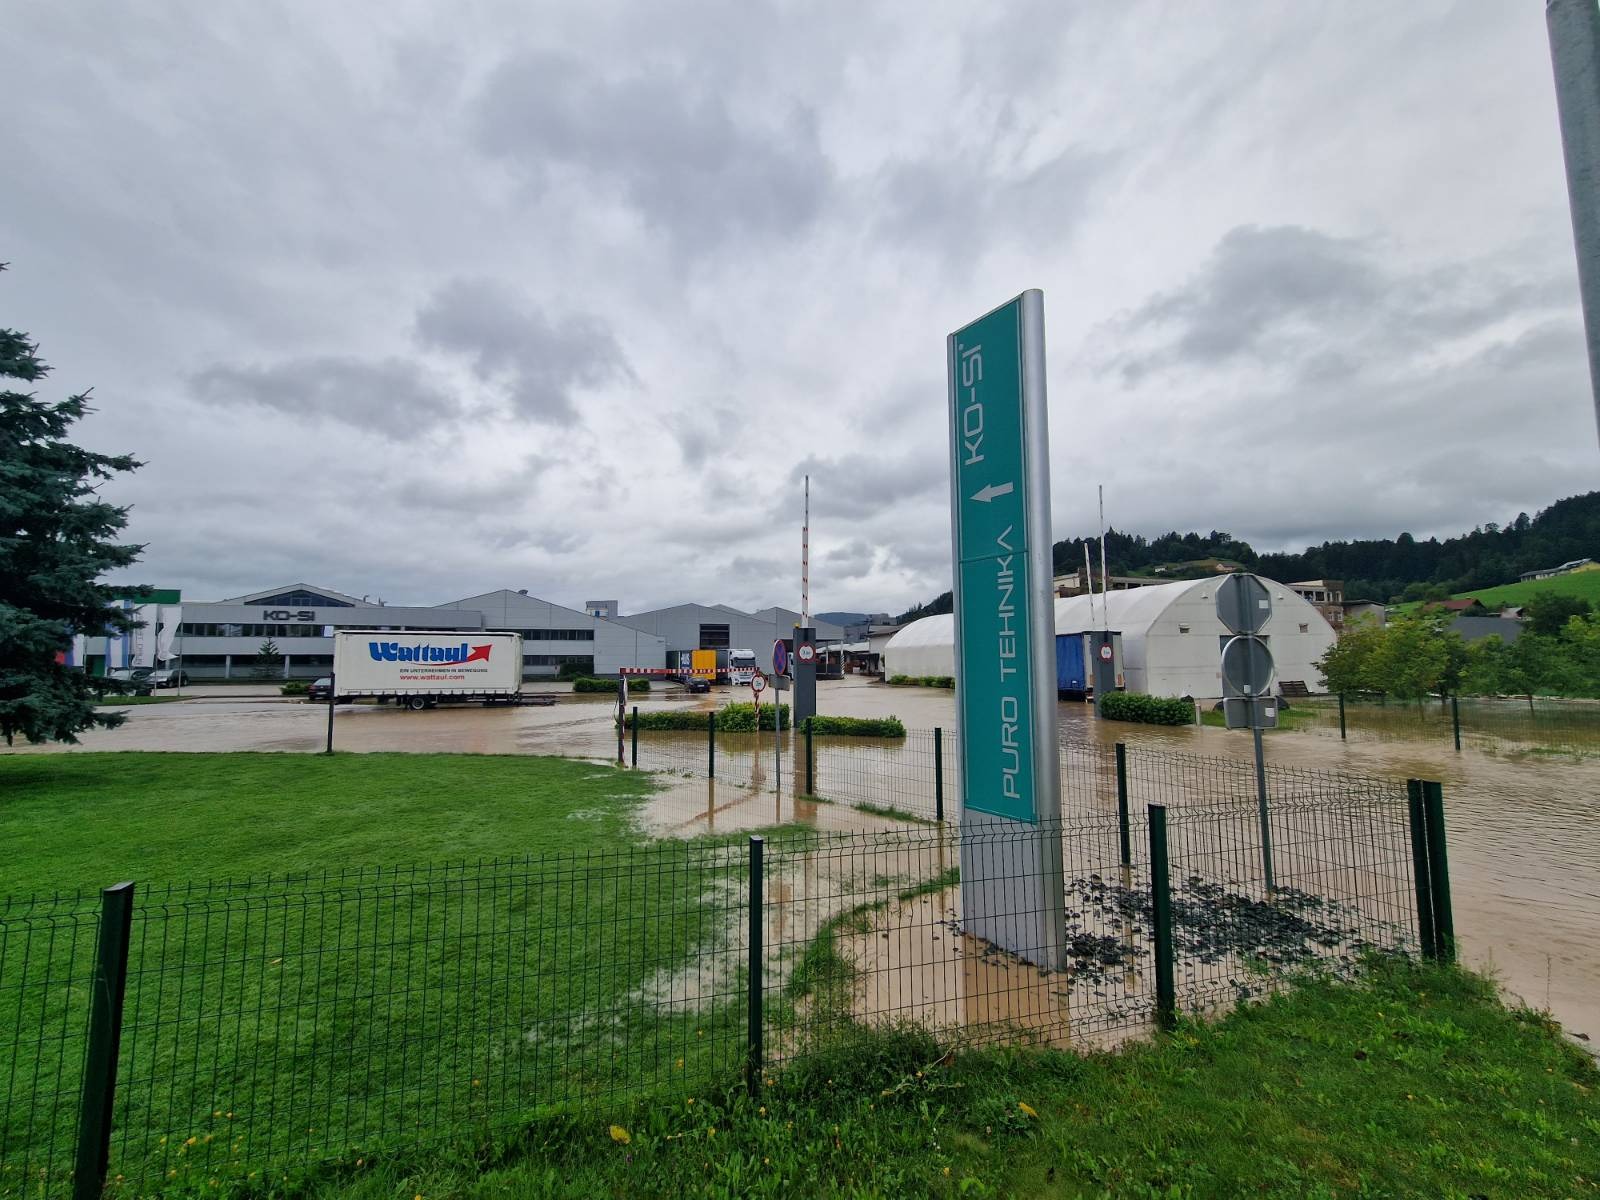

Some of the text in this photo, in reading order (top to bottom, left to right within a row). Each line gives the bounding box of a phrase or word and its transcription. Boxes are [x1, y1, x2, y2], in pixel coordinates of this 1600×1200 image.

[263, 610, 316, 622] KO-SI
[368, 642, 468, 662] Wattaul
[996, 523, 1021, 799] PURO TEHNIKA
